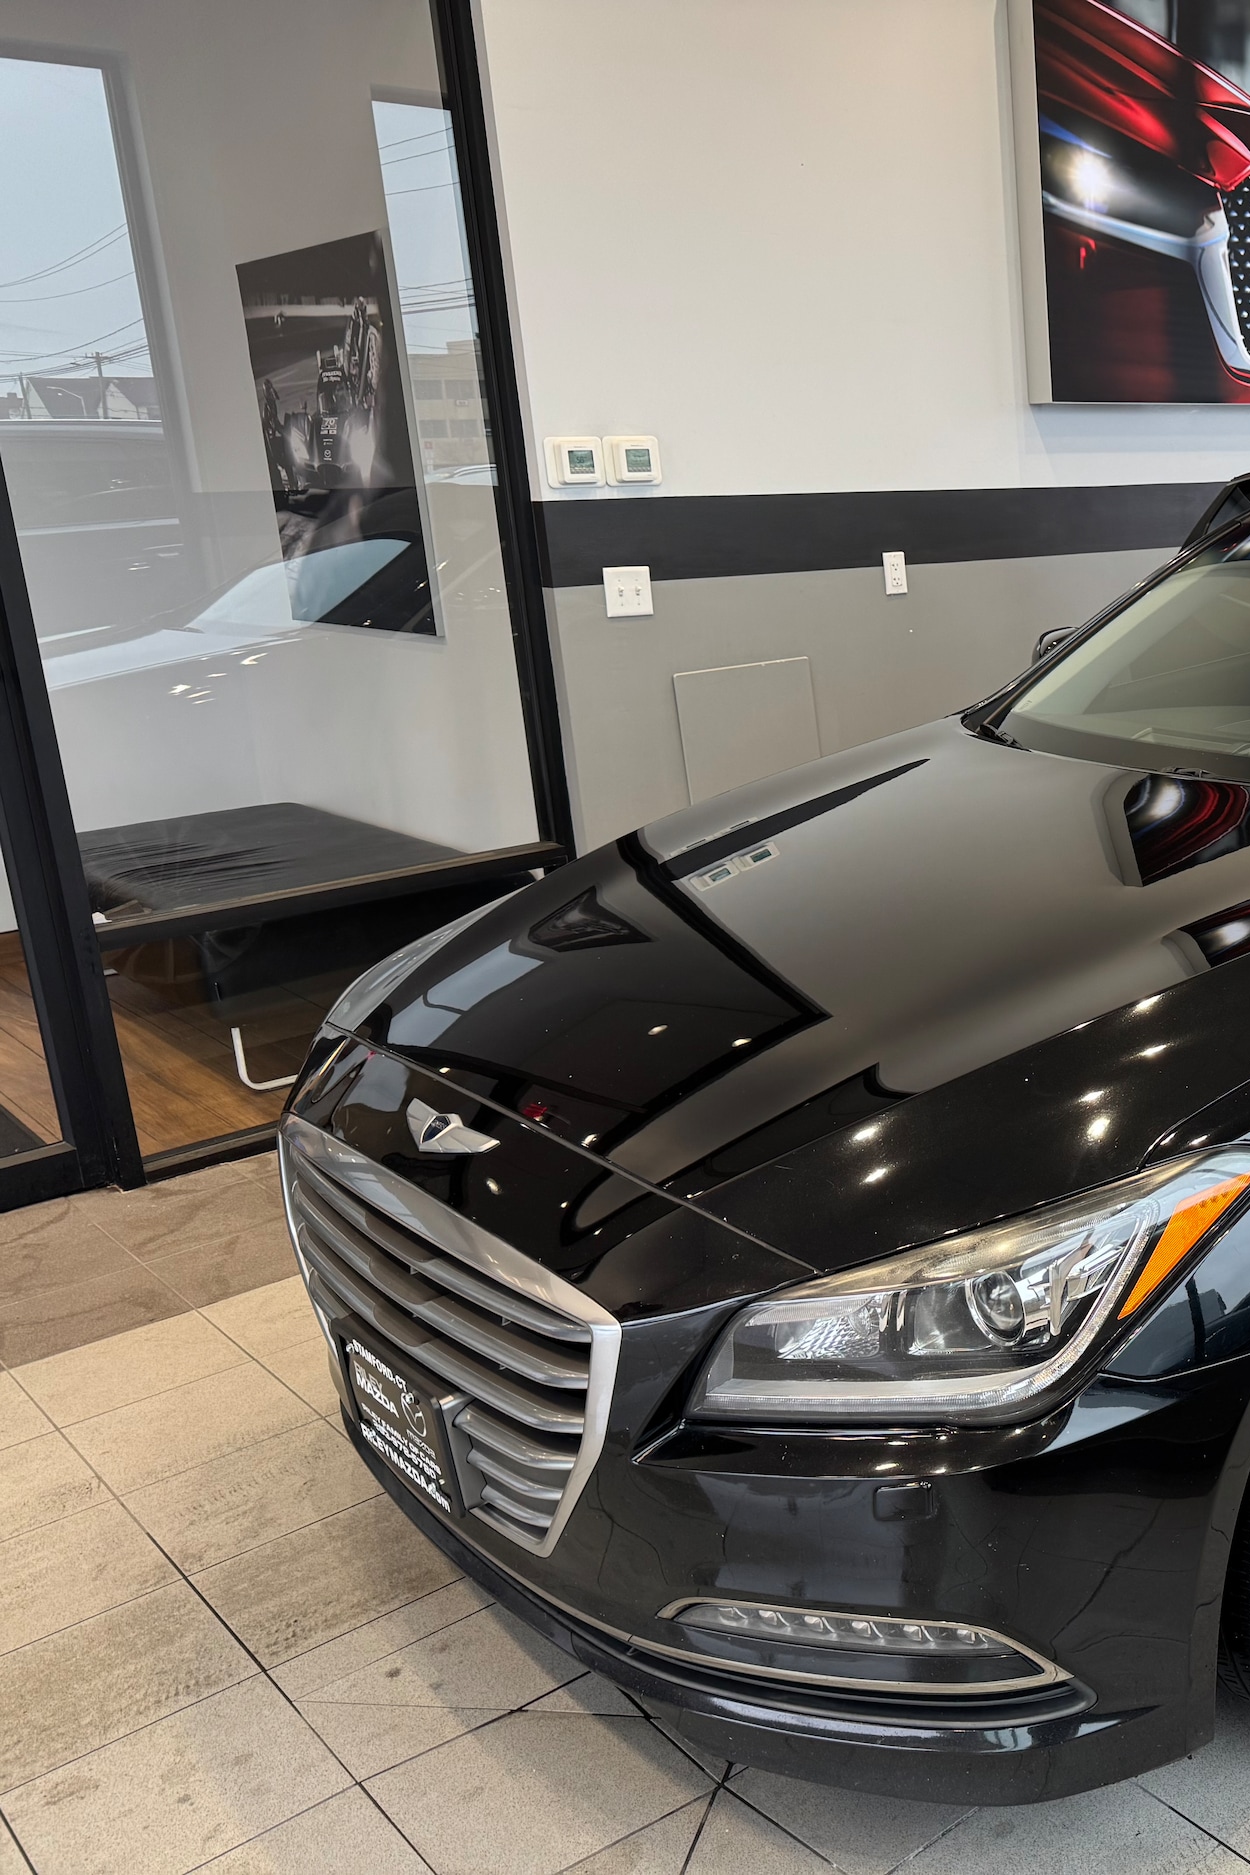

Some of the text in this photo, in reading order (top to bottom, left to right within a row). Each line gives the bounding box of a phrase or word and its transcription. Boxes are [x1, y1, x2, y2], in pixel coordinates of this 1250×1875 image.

[353, 1360, 382, 1391] RILEY
[395, 1375, 407, 1393] CT
[356, 1371, 399, 1418] MAZDA
